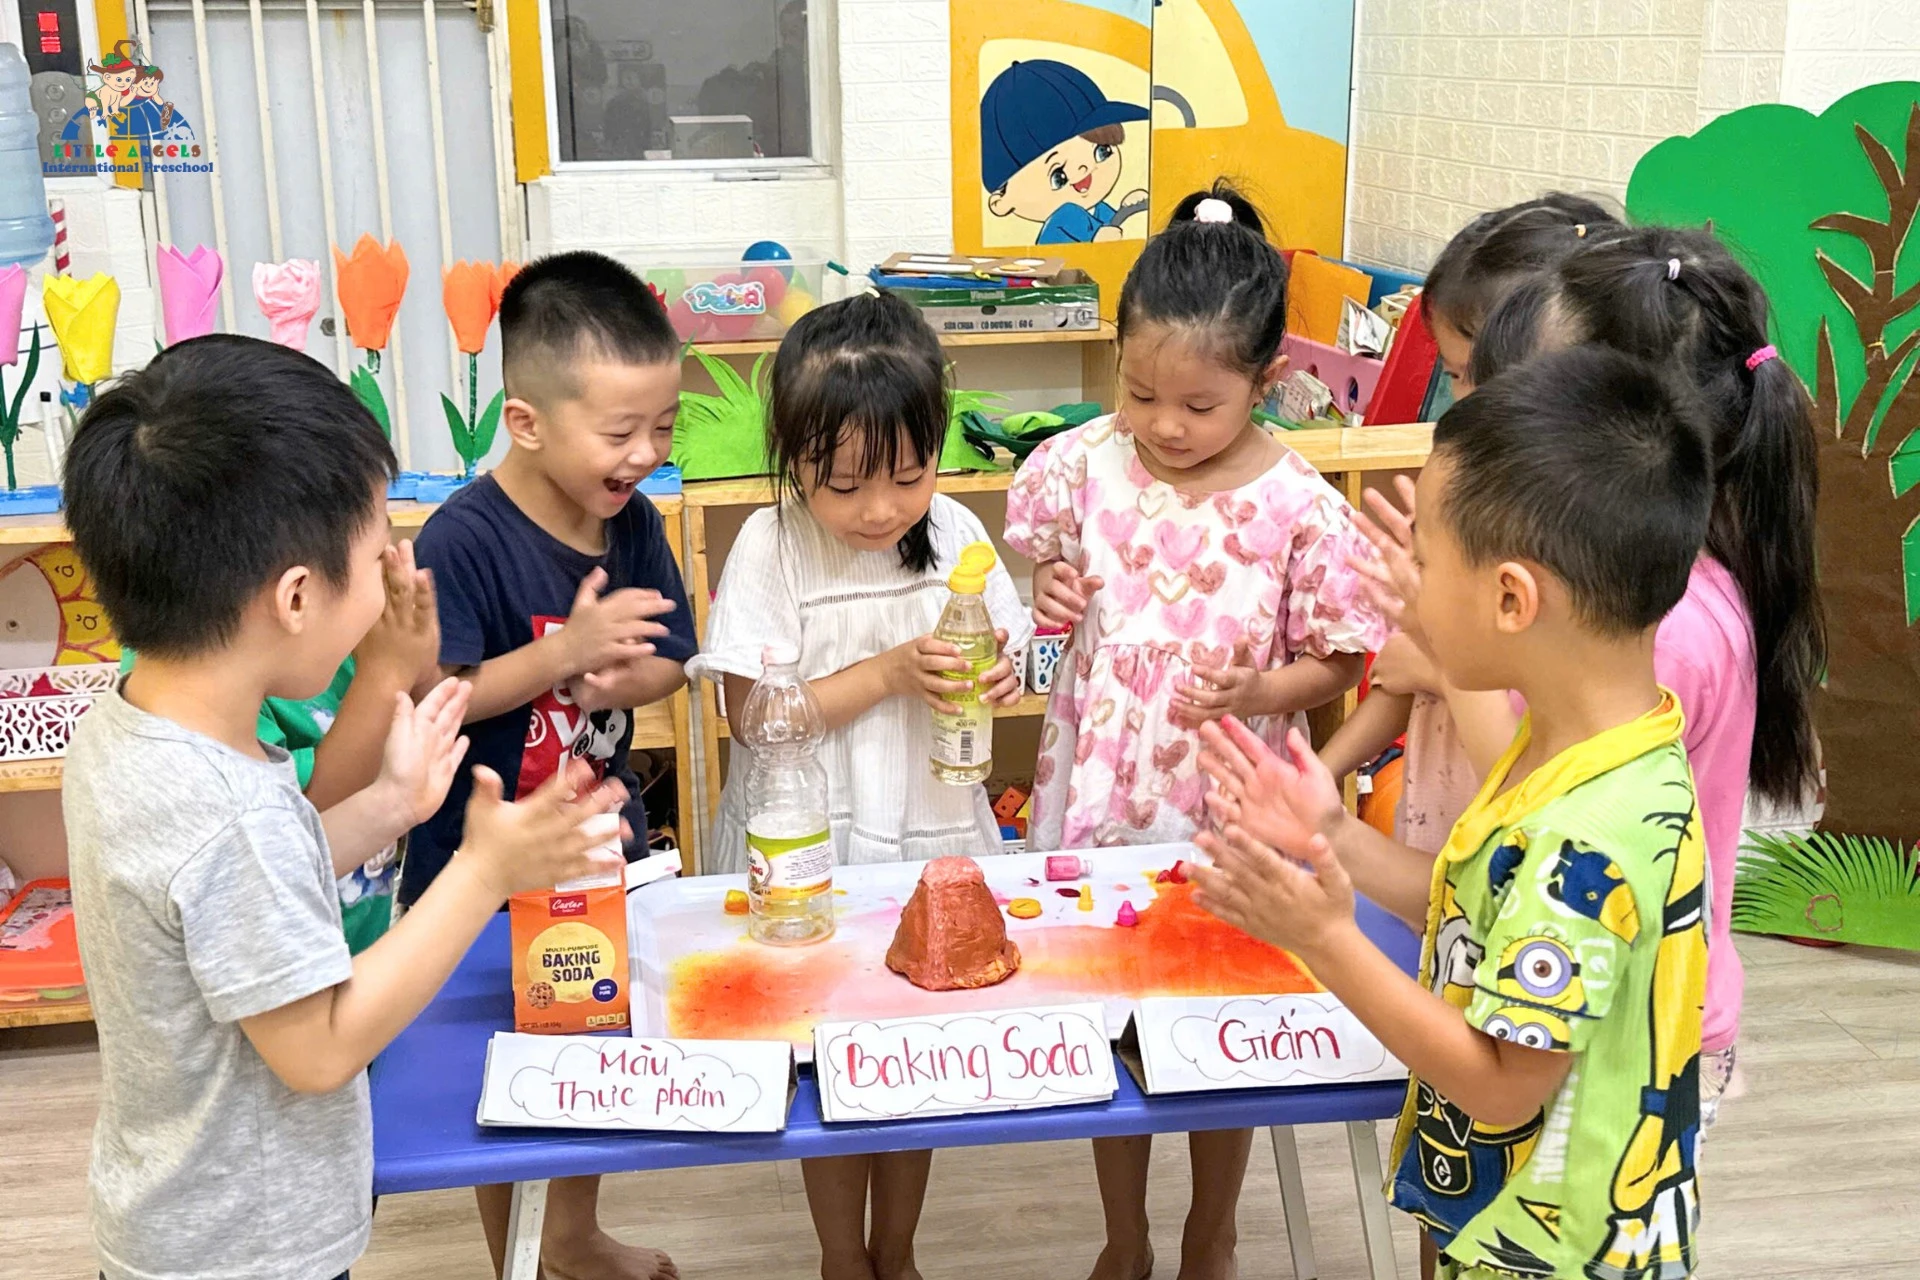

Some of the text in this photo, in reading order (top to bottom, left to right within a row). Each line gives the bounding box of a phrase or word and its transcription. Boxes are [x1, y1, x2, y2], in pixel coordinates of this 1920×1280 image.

[542, 950, 600, 968] BAKING
[552, 967, 595, 983] SODA
[1218, 1008, 1341, 1065] Giấm
[600, 1045, 668, 1077] Màu
[847, 1022, 1094, 1100] Baking Soda
[551, 1072, 725, 1116] Thực phẩm
